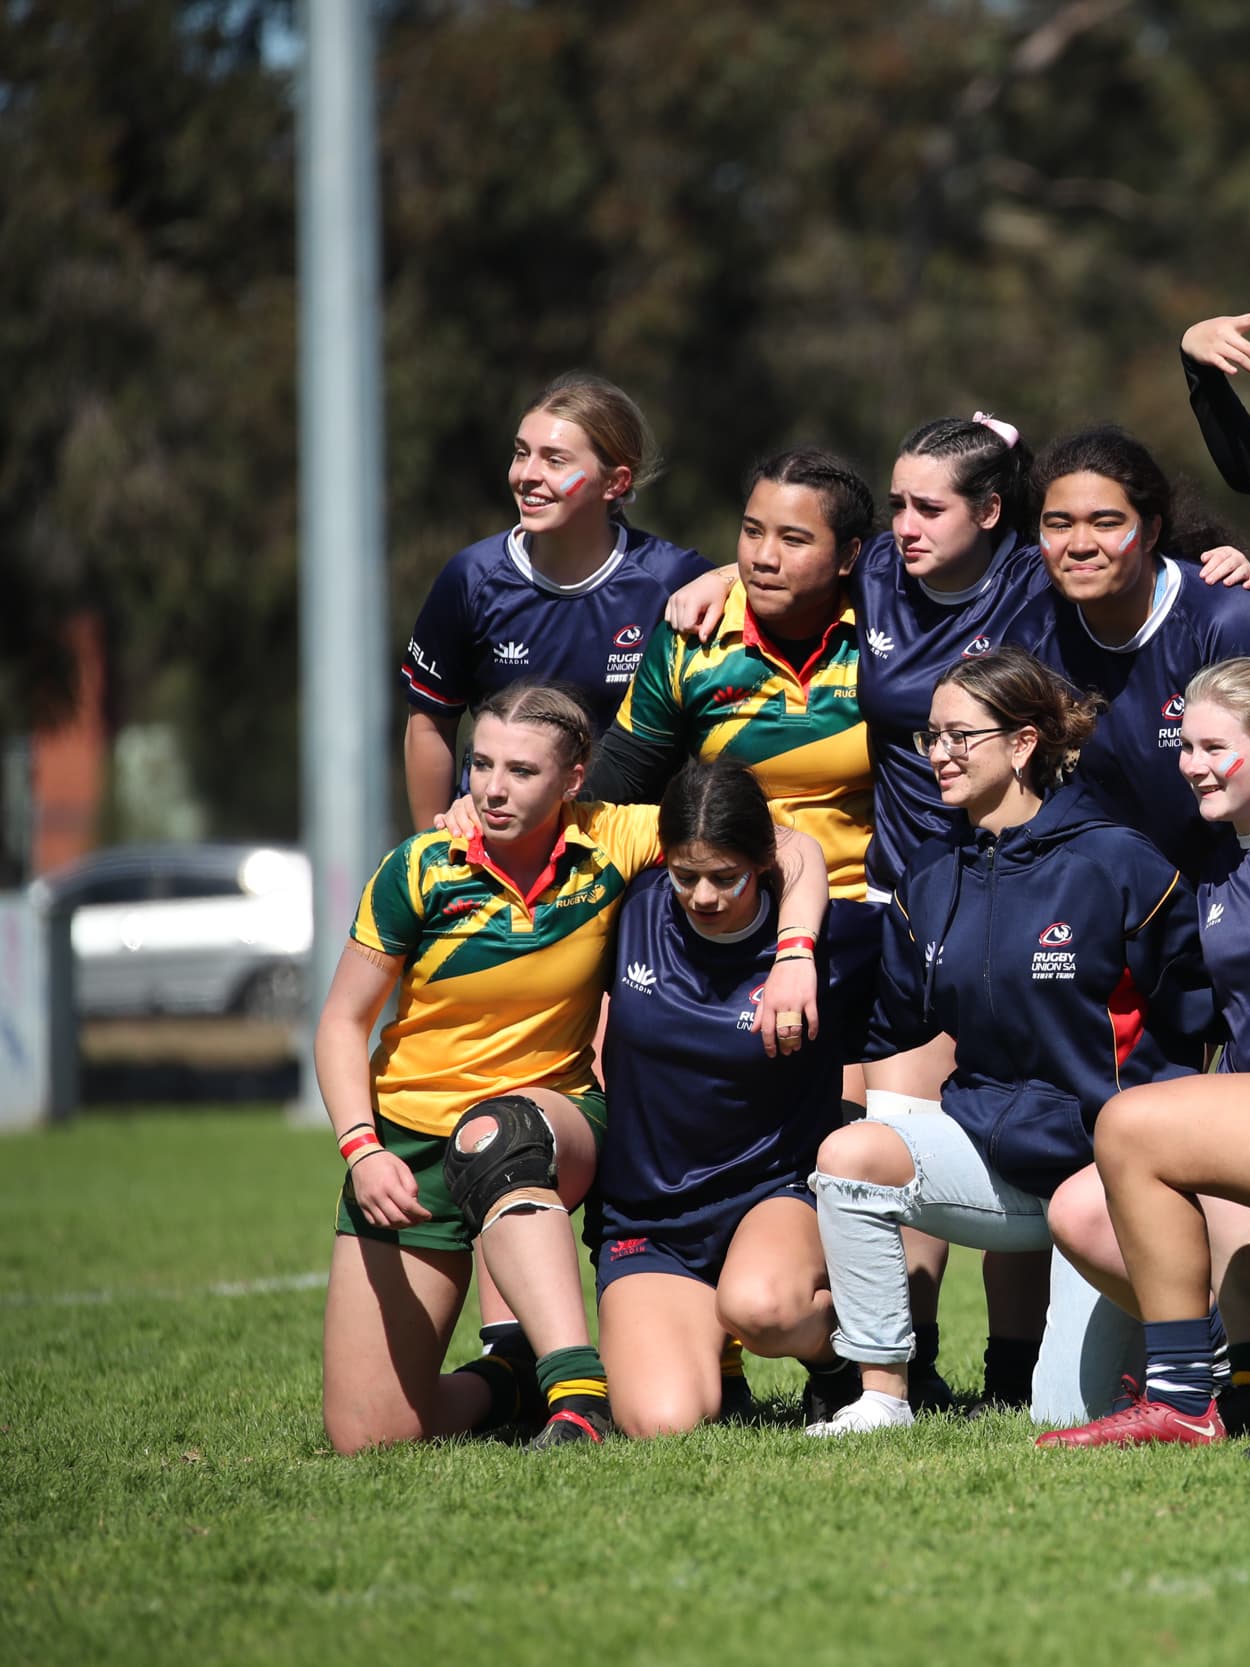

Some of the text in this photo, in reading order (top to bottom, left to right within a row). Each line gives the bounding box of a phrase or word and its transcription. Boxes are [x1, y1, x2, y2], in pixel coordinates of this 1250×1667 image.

[608, 653, 643, 663] RUGB
[833, 689, 857, 698] RUG
[555, 894, 588, 909] RUGBY
[1033, 952, 1076, 963] RUGBY
[1031, 962, 1076, 972] UNION SA
